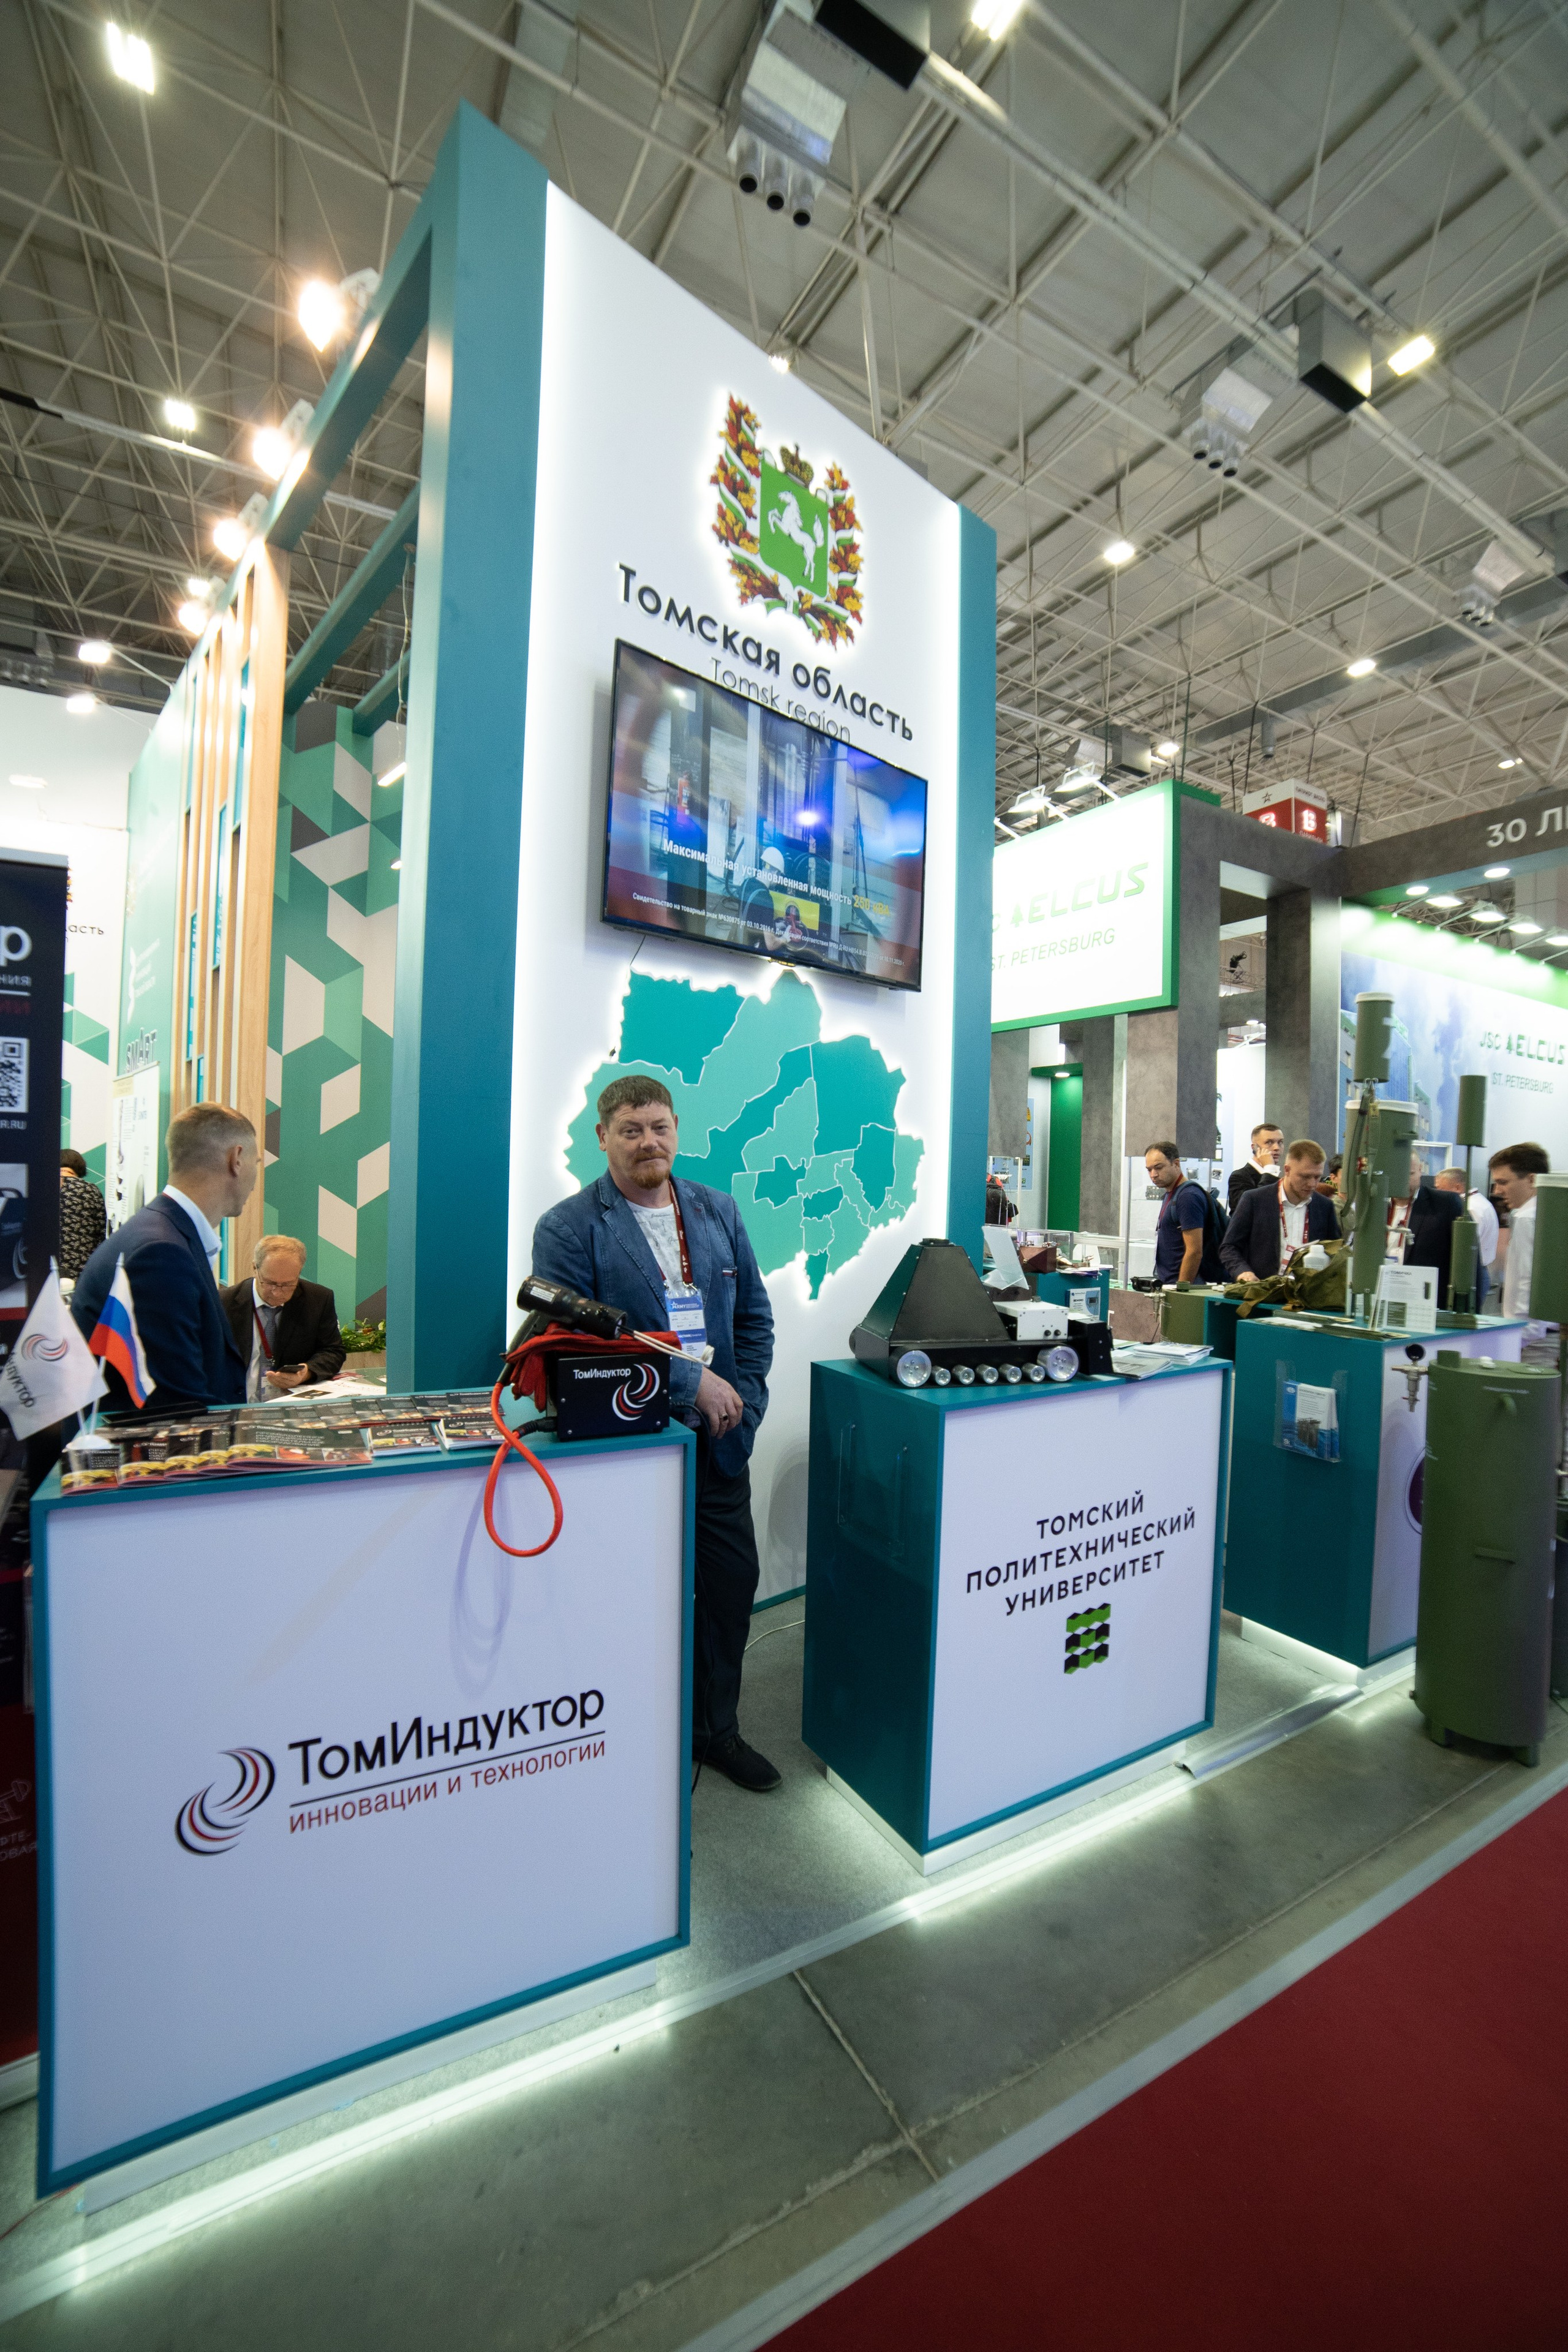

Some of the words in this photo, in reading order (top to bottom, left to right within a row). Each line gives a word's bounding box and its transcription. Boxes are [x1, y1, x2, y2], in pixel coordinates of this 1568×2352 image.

[618, 562, 780, 675] Томская
[793, 663, 914, 742] область
[711, 657, 780, 709] Tomsk
[787, 699, 851, 743] region
[1486, 818, 1528, 848] 30
[1534, 804, 1568, 837] Л
[663, 839, 739, 871] Максимальная
[742, 864, 809, 893] установленная
[810, 885, 852, 905] мощность
[853, 894, 870, 911] 250
[633, 892, 673, 909] Свидетельство
[681, 905, 706, 917] товарный
[66, 924, 104, 936] асть
[1011, 928, 1115, 967] PETERSBURG
[1479, 1031, 1501, 1050] JSC
[1493, 1072, 1503, 1086] ST.
[1506, 1074, 1554, 1094] PETERSBURG
[573, 1368, 631, 1379] ТомИндуктор
[1036, 1490, 1144, 1539] ТОМСКИЙ
[966, 1506, 1196, 1594] ПОЛИТЕХНИЧЕСКИЙ
[1005, 1550, 1165, 1616] УНИВЕРСИТЕТ
[288, 1689, 605, 1786] ТомИндуктор
[289, 1781, 438, 1835] инновации
[448, 1776, 462, 1796] и
[471, 1740, 606, 1789] технологии
